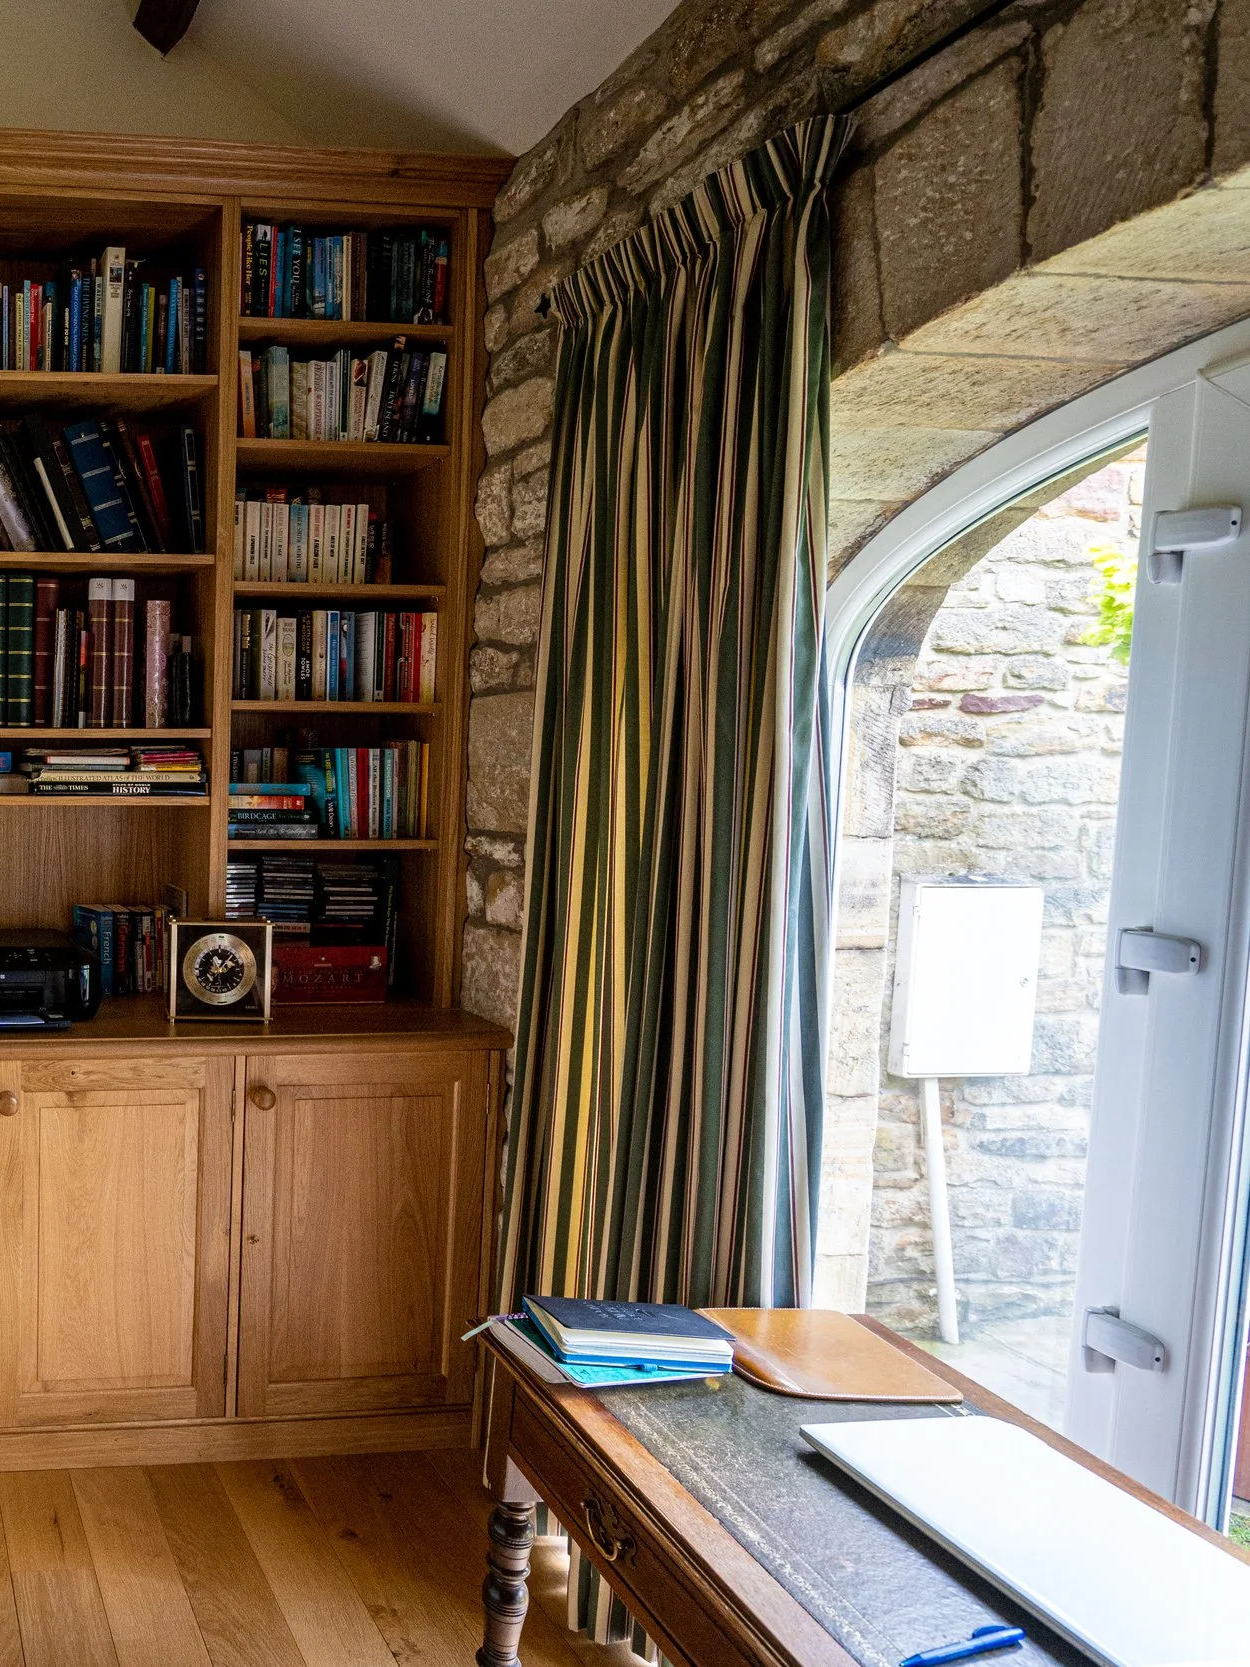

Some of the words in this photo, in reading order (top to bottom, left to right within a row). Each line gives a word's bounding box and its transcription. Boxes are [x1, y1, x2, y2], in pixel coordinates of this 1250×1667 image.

[293, 237, 301, 256] SEE
[259, 243, 268, 276] LIES
[292, 259, 301, 283] YOU
[196, 289, 204, 340] THRUST
[387, 390, 395, 409] HOLY
[382, 411, 393, 437] ISLAND
[267, 652, 275, 687] GOLDFINCH
[112, 786, 151, 794] HISTORY
[237, 811, 277, 820] BIRDCAGE
[103, 931, 112, 965] French
[117, 925, 127, 972] German
[282, 973, 362, 984] MOZART
